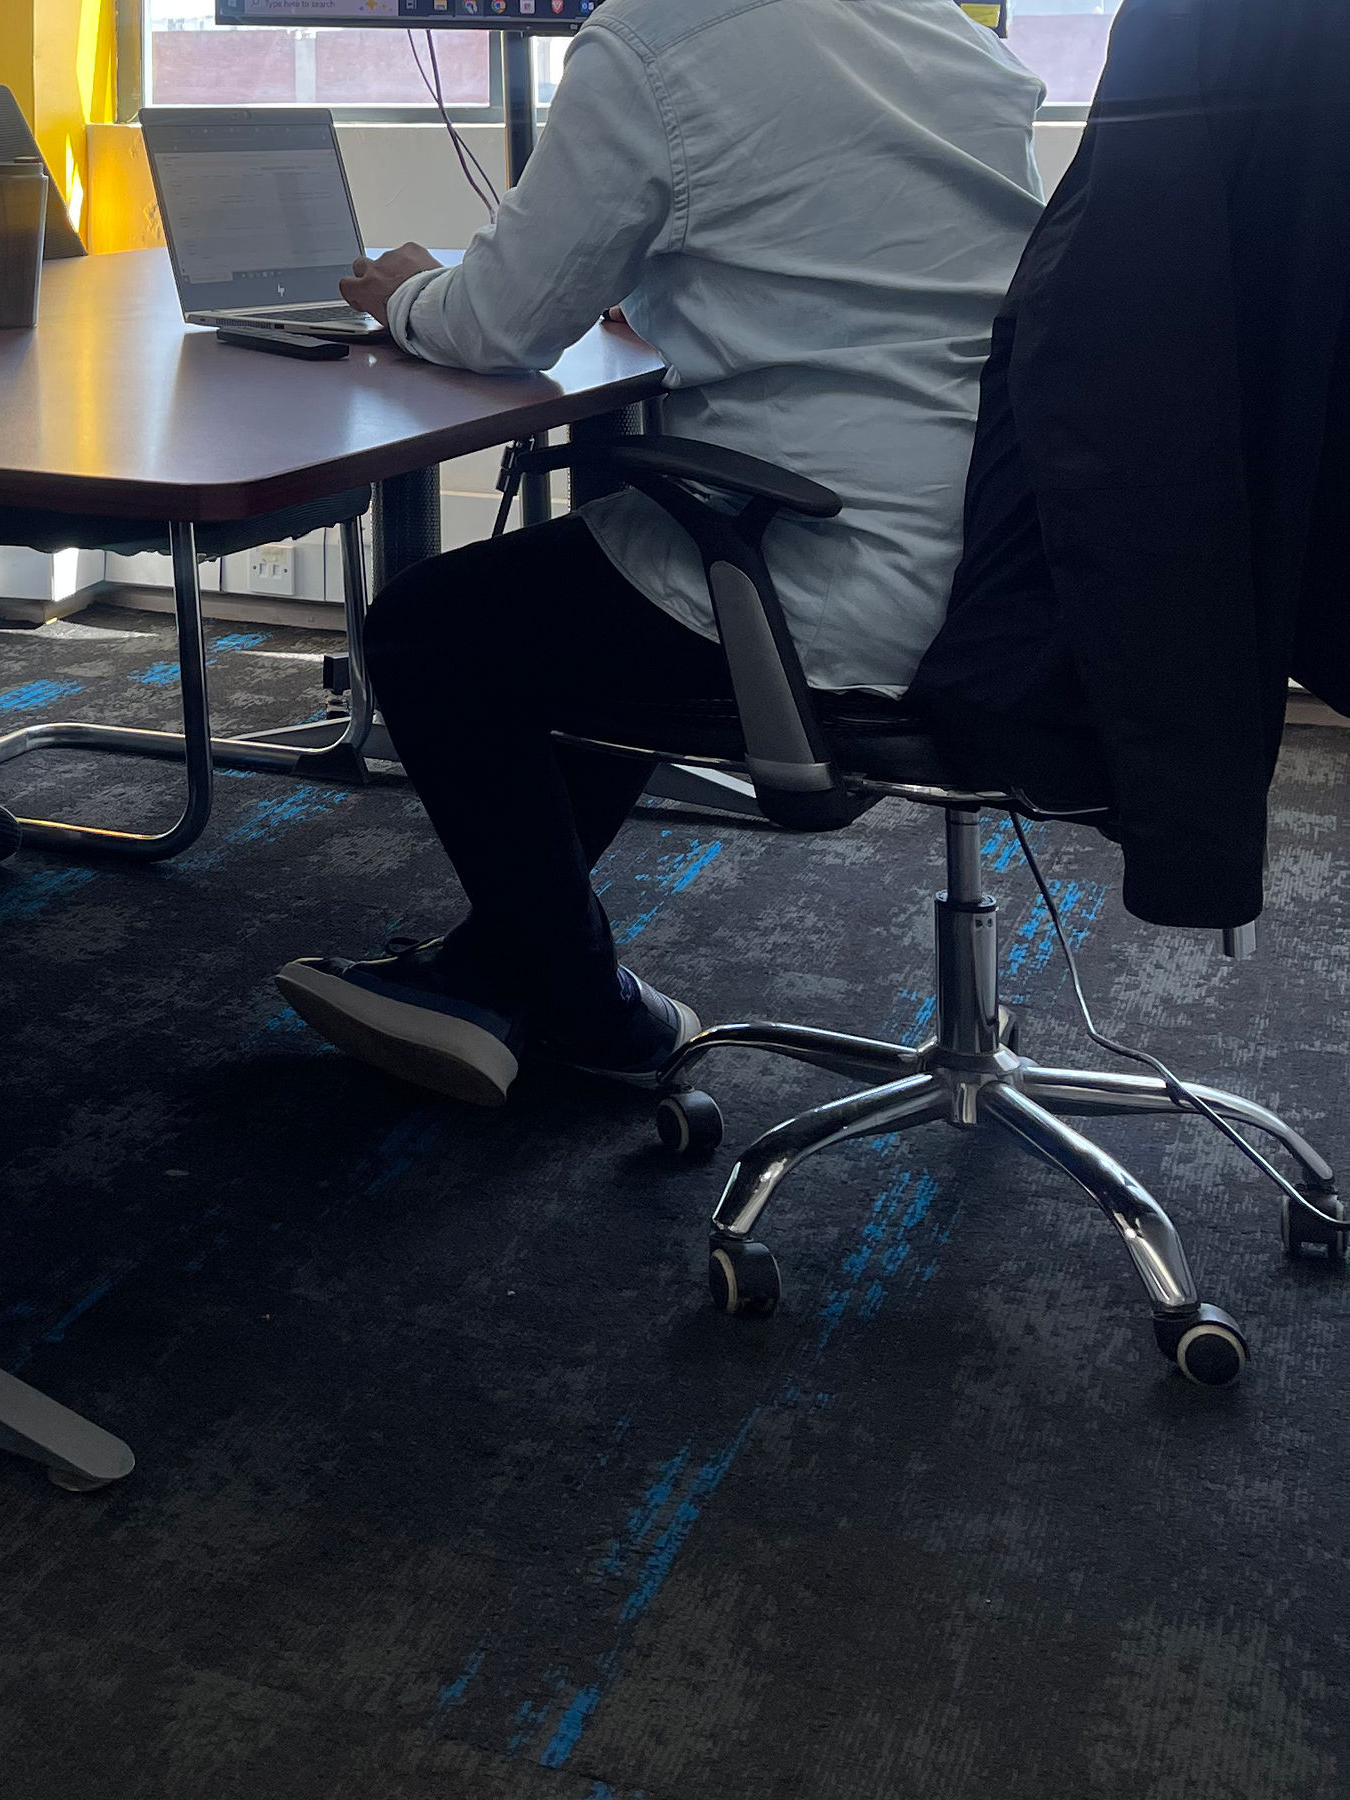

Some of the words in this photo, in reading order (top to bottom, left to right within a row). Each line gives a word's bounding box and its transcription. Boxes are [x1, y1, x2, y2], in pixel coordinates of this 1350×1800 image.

[265, 0, 283, 9] Type
[283, 0, 299, 8] here
[301, 0, 309, 8] to
[311, 0, 335, 8] search
